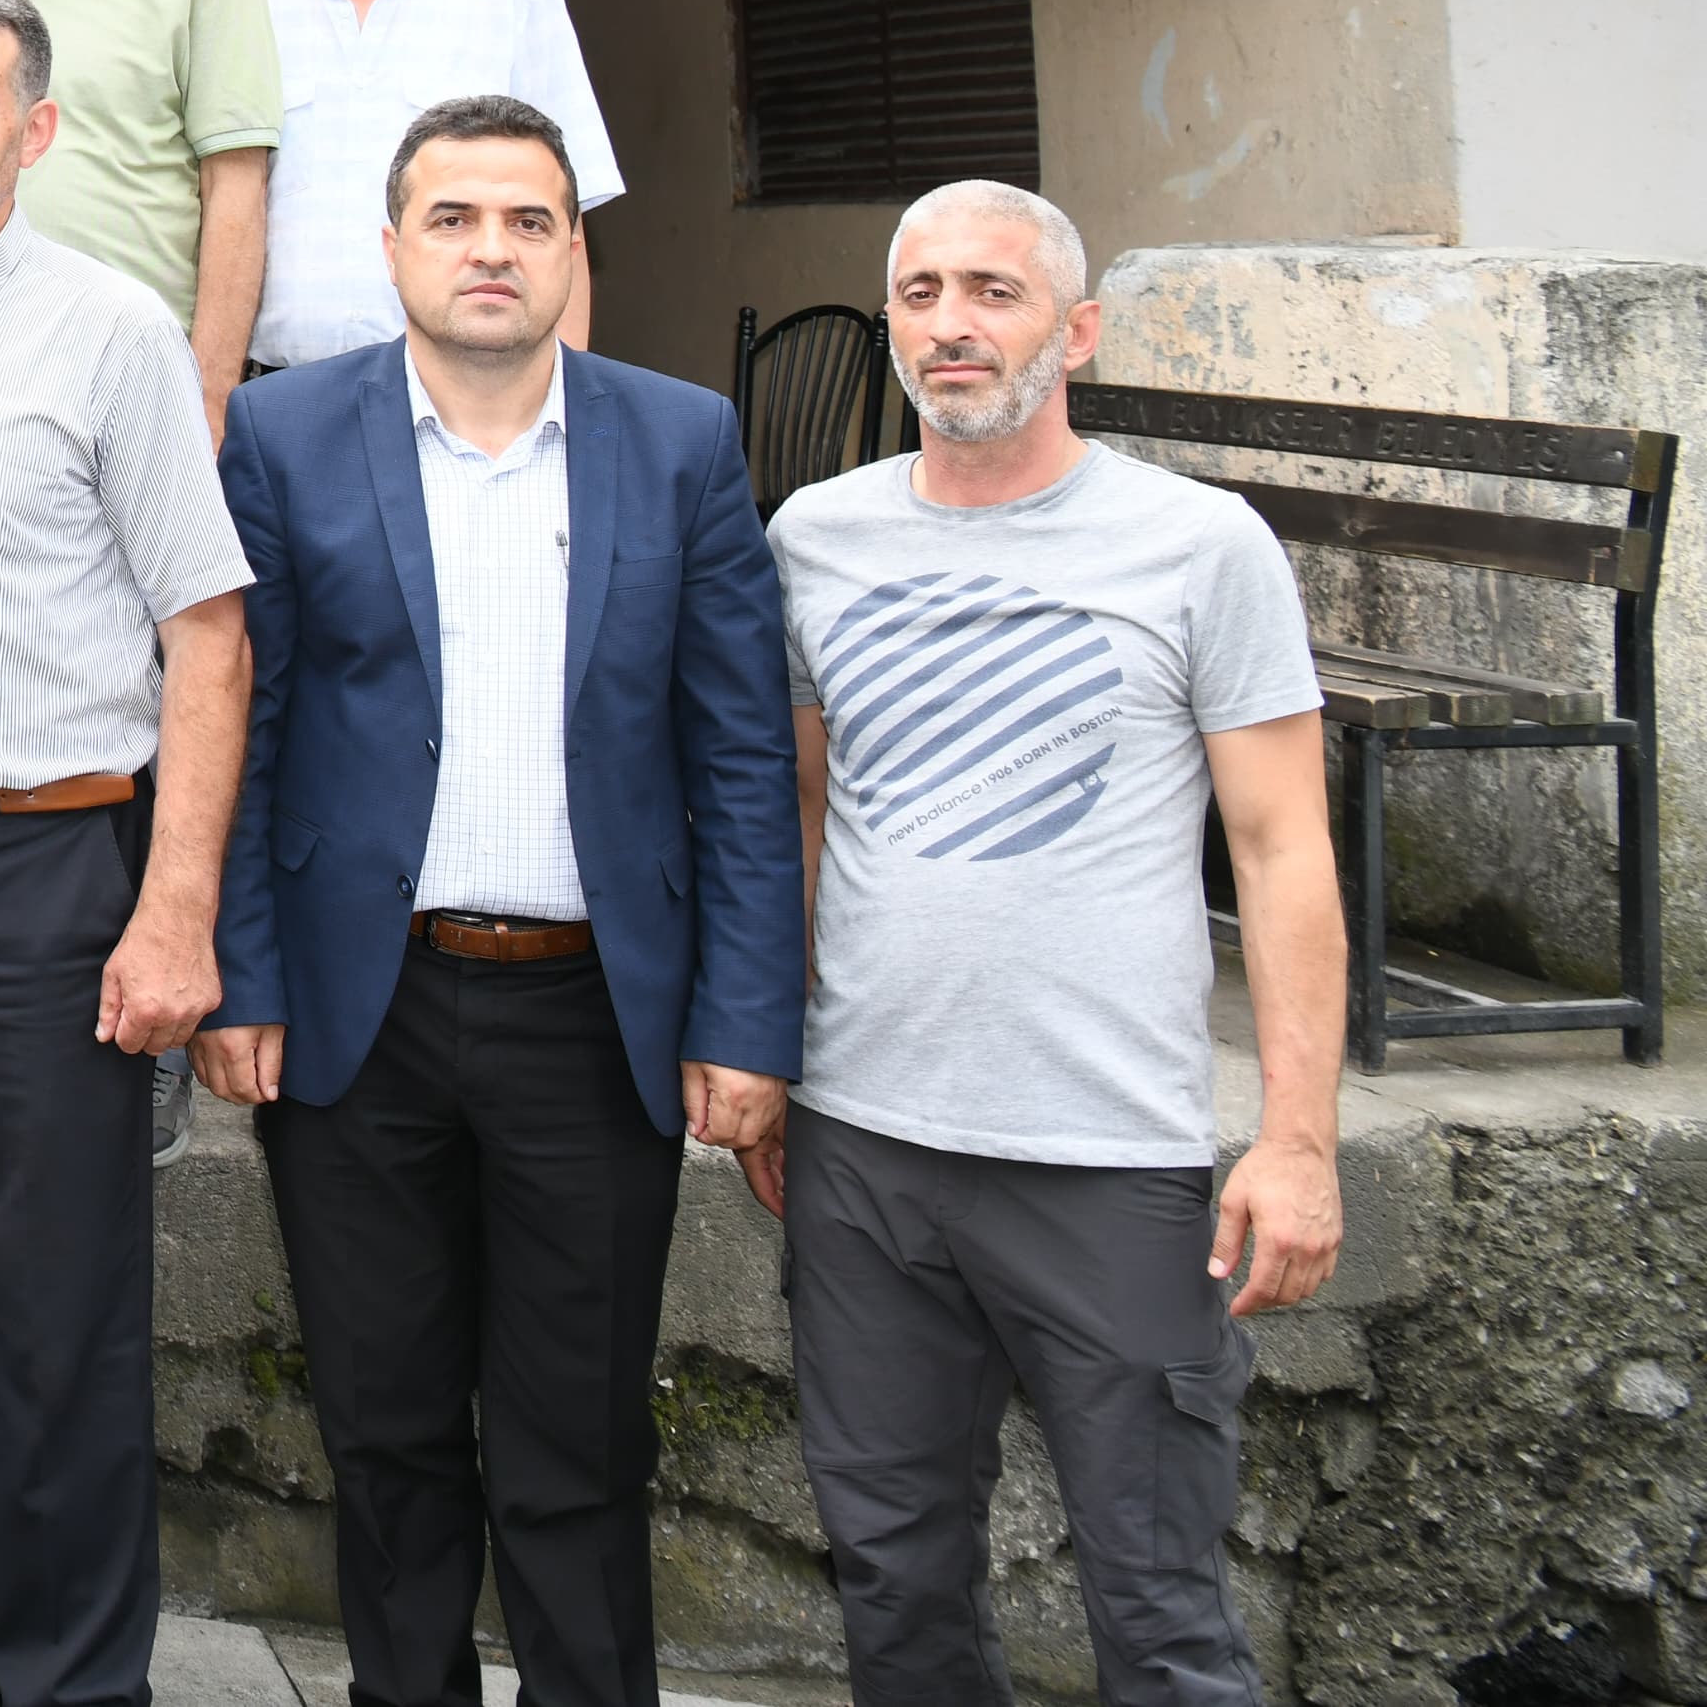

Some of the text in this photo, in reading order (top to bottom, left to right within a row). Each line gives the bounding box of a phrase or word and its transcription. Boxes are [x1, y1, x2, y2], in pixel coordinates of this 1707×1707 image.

[886, 705, 1125, 846] new balance 1906 BORN IN BOSTON
